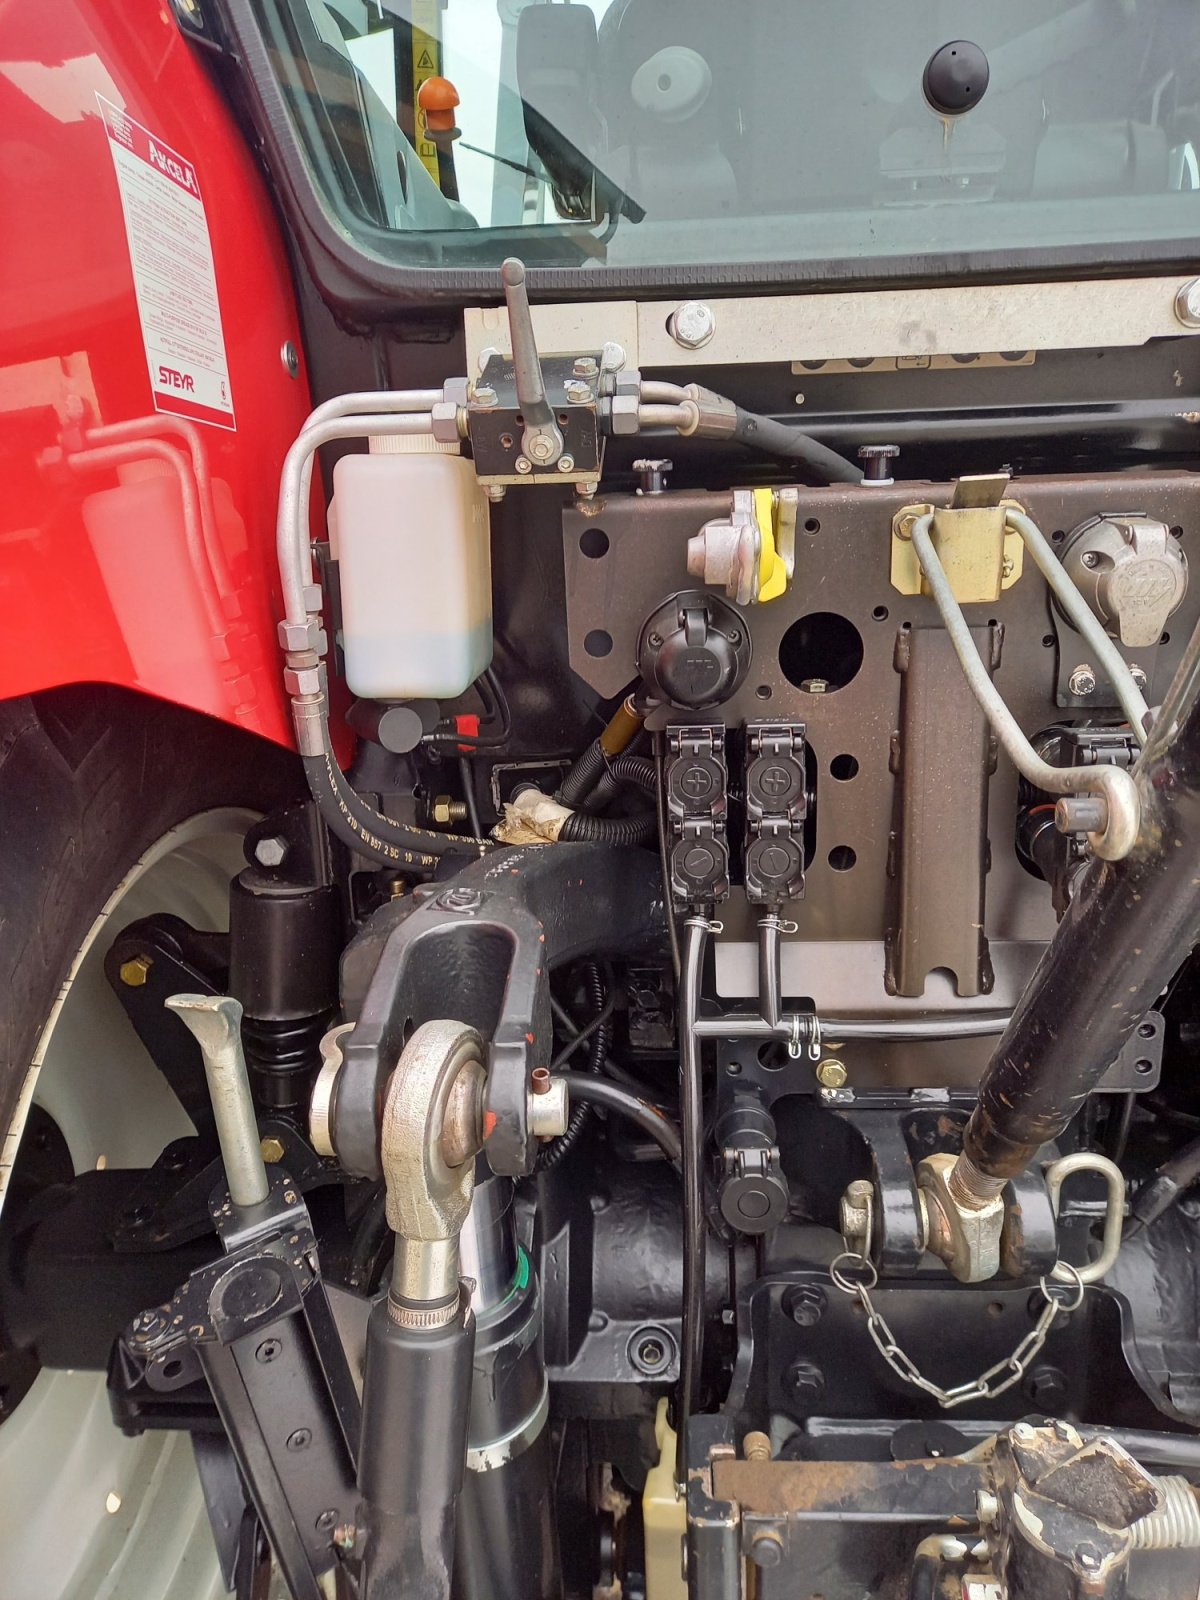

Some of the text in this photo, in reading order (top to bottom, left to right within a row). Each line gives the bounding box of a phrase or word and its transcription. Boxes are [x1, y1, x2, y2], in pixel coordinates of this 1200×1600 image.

[159, 366, 195, 392] STEYR
[360, 830, 370, 844] EN
[370, 836, 382, 851] 857
[390, 847, 399, 859] SC
[421, 855, 433, 865] WP
